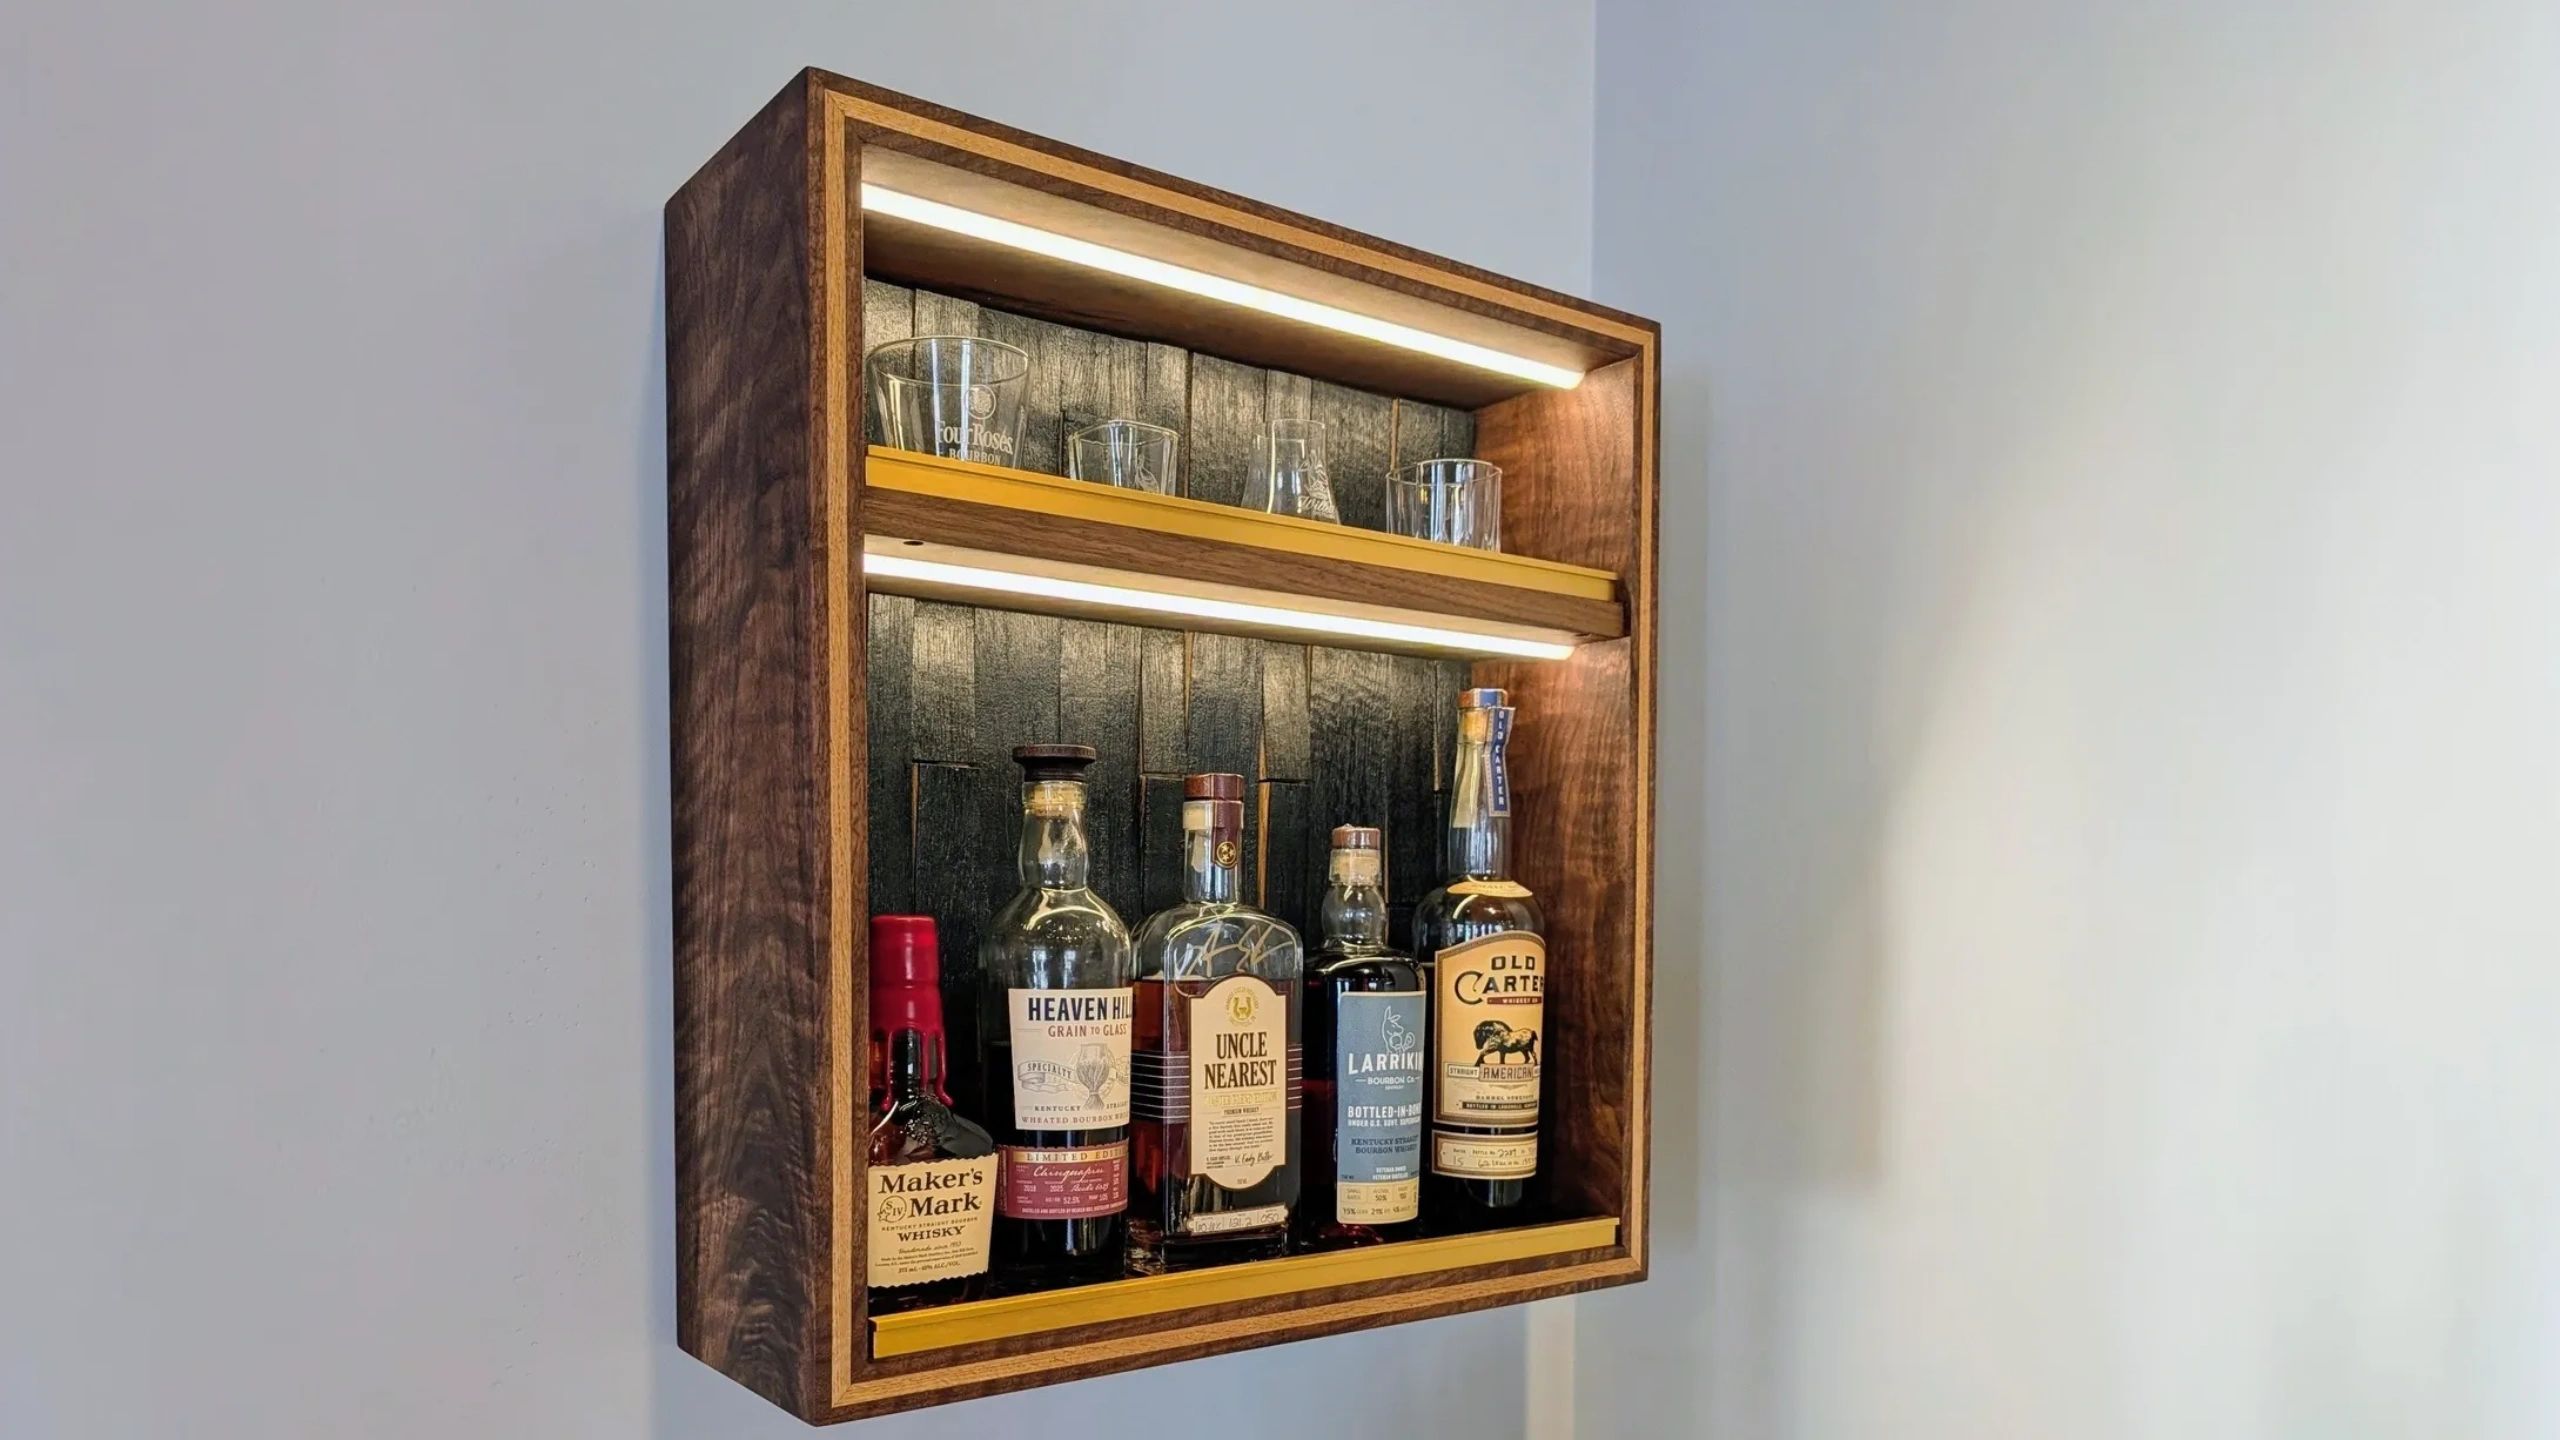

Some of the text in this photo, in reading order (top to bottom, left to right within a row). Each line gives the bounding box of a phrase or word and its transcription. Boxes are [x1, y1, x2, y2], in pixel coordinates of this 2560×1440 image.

[936, 421, 1013, 455] Four Roses
[1495, 745, 1504, 804] CARTER
[1491, 955, 1535, 970] OLD
[1028, 997, 1107, 1020] HEAVEN
[1048, 1025, 1087, 1037] GRAIN
[1103, 1024, 1127, 1035] GLASS
[1216, 1032, 1268, 1059] UNCLE
[1027, 1062, 1072, 1079] SPECIALTY
[1204, 1060, 1277, 1089] NEAREST
[1449, 1067, 1478, 1075] STRAIGHT
[1483, 1066, 1532, 1080] AMERICAN
[1367, 1076, 1405, 1085] BOURBON
[1073, 1115, 1113, 1124] BOURBON
[1351, 1138, 1394, 1146] KENTUCKY
[1355, 1146, 1393, 1154] BOURBON
[1027, 1152, 1088, 1161] LIMITED
[878, 1168, 983, 1194] Maker's
[908, 1192, 980, 1218] Mark
[881, 1224, 917, 1232] KENTUCKY
[919, 1221, 949, 1229] STRAIGHT
[897, 1225, 966, 1242] WHISKY
